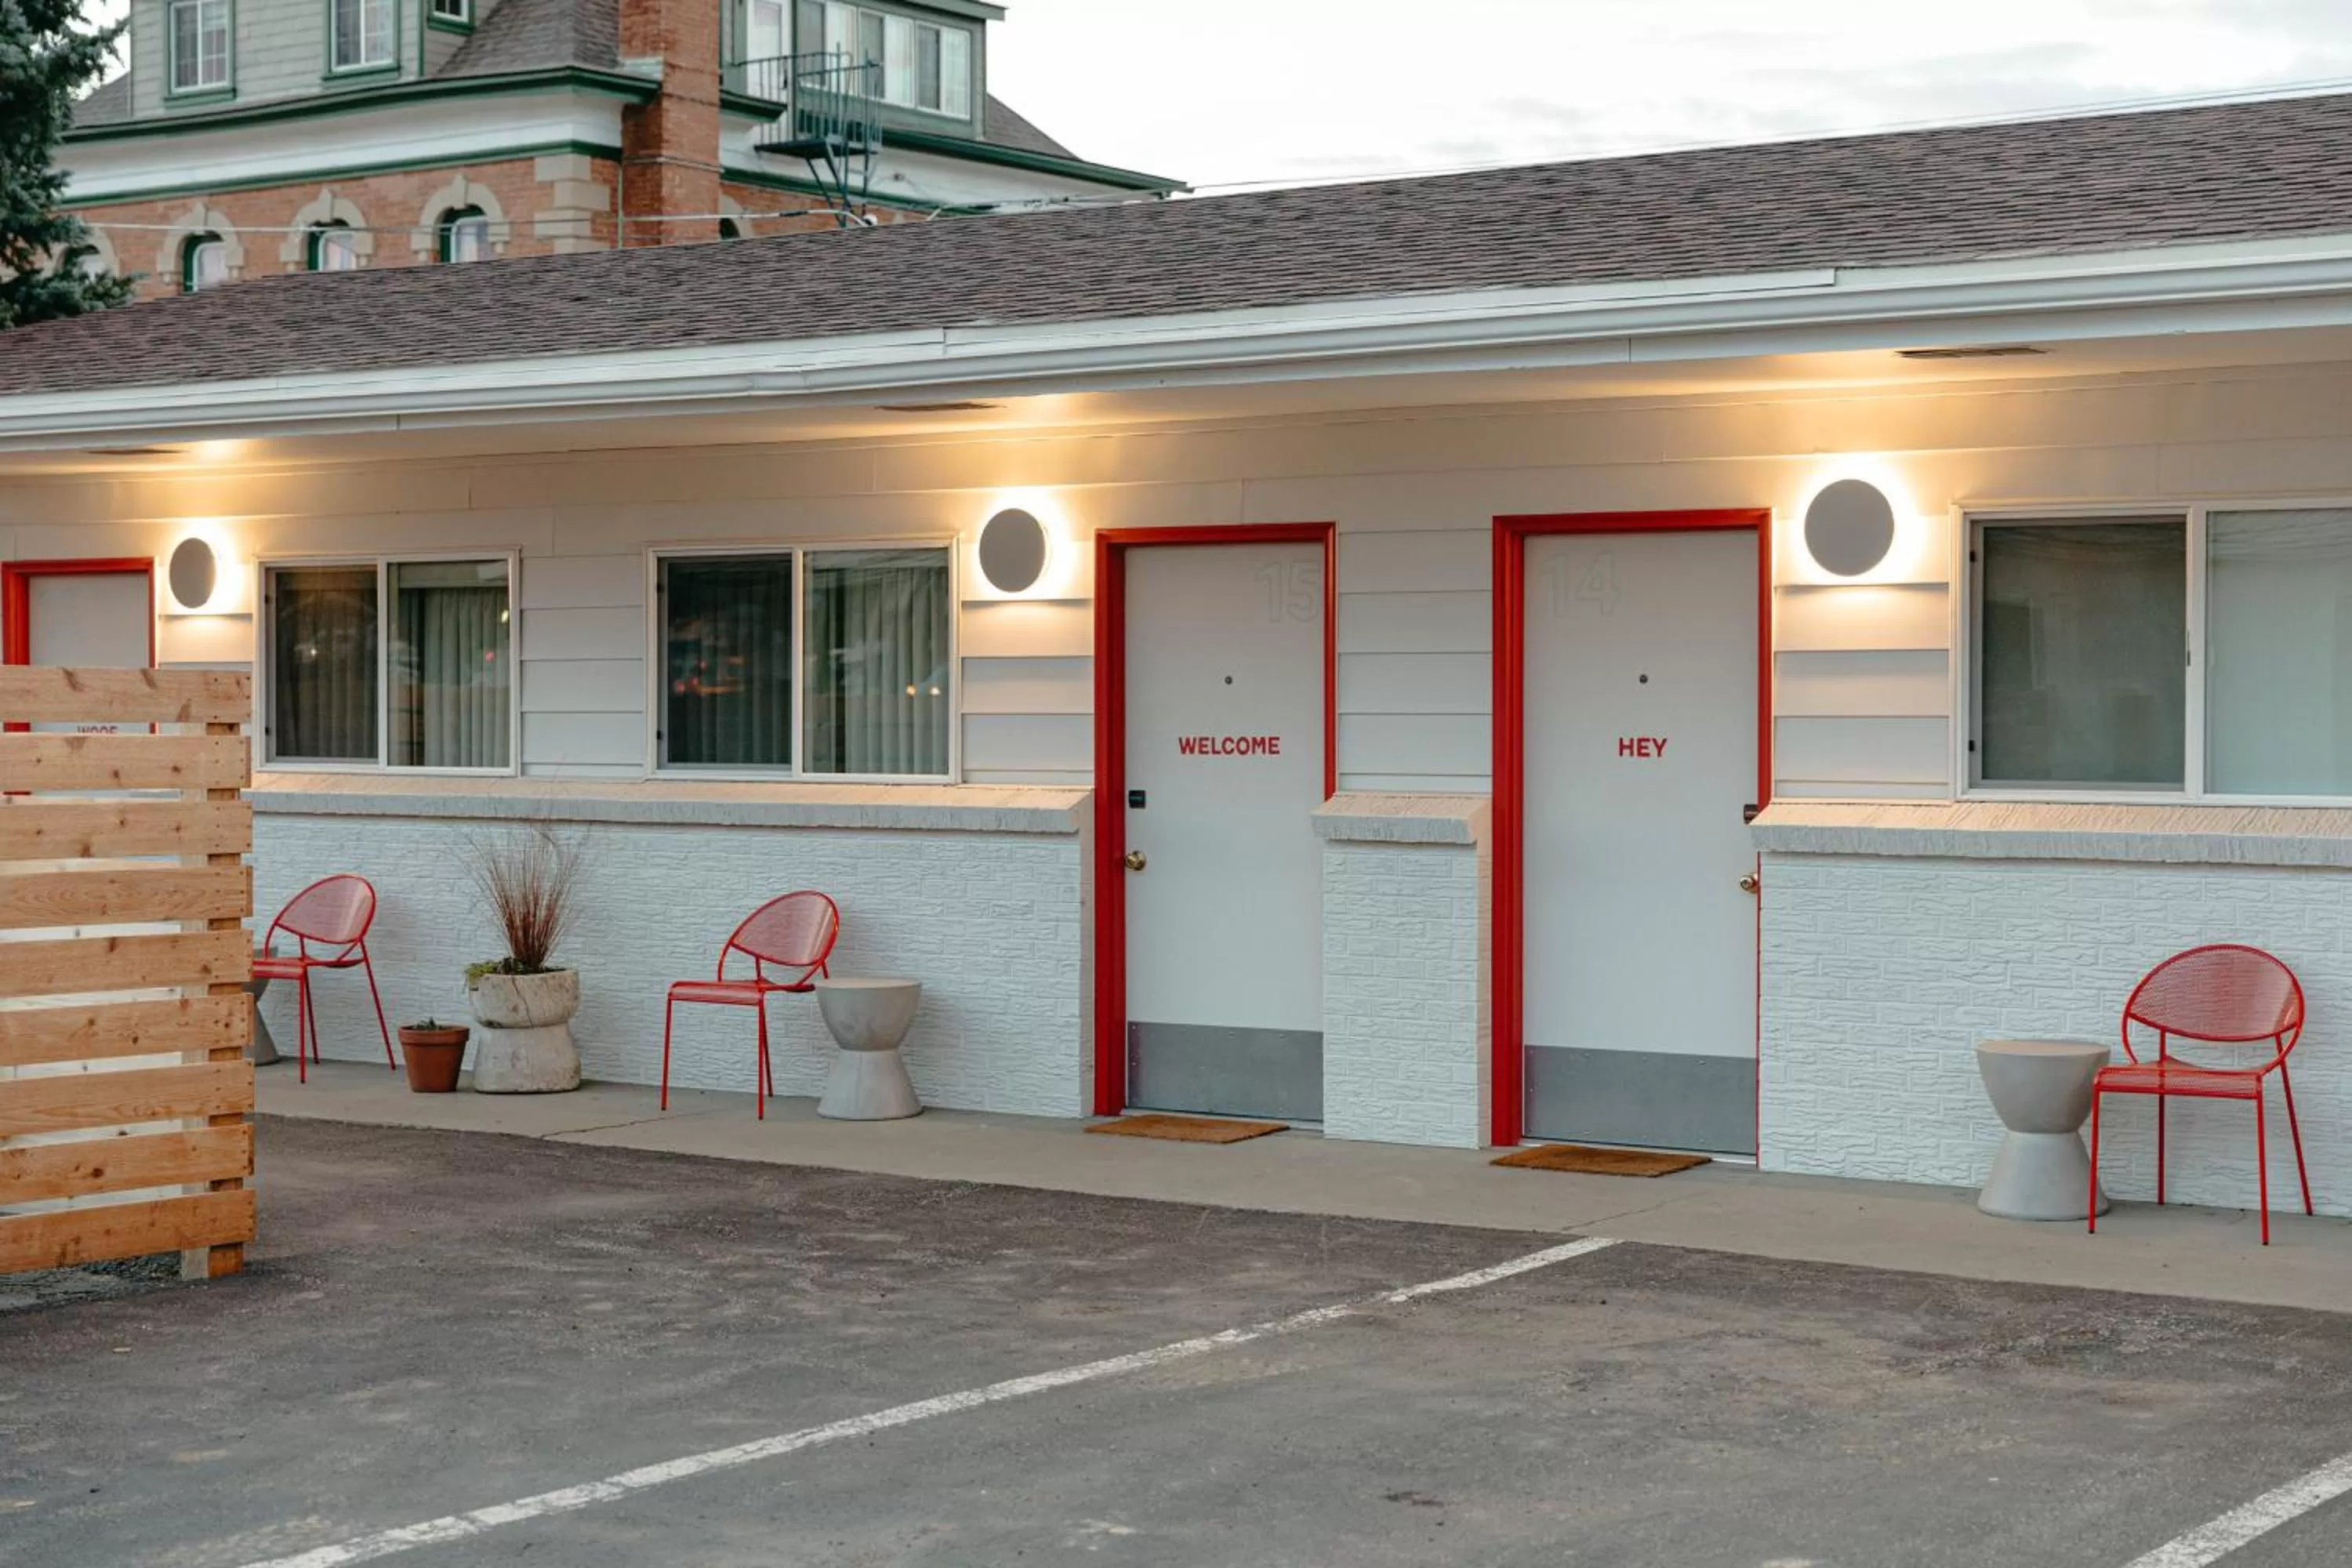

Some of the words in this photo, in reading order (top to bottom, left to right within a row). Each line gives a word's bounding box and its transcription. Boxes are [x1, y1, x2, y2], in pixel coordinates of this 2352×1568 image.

[1256, 559, 1319, 622] 15
[1541, 550, 1621, 620] 14
[1178, 736, 1280, 755] WELCOME
[1619, 737, 1668, 757] HEY
